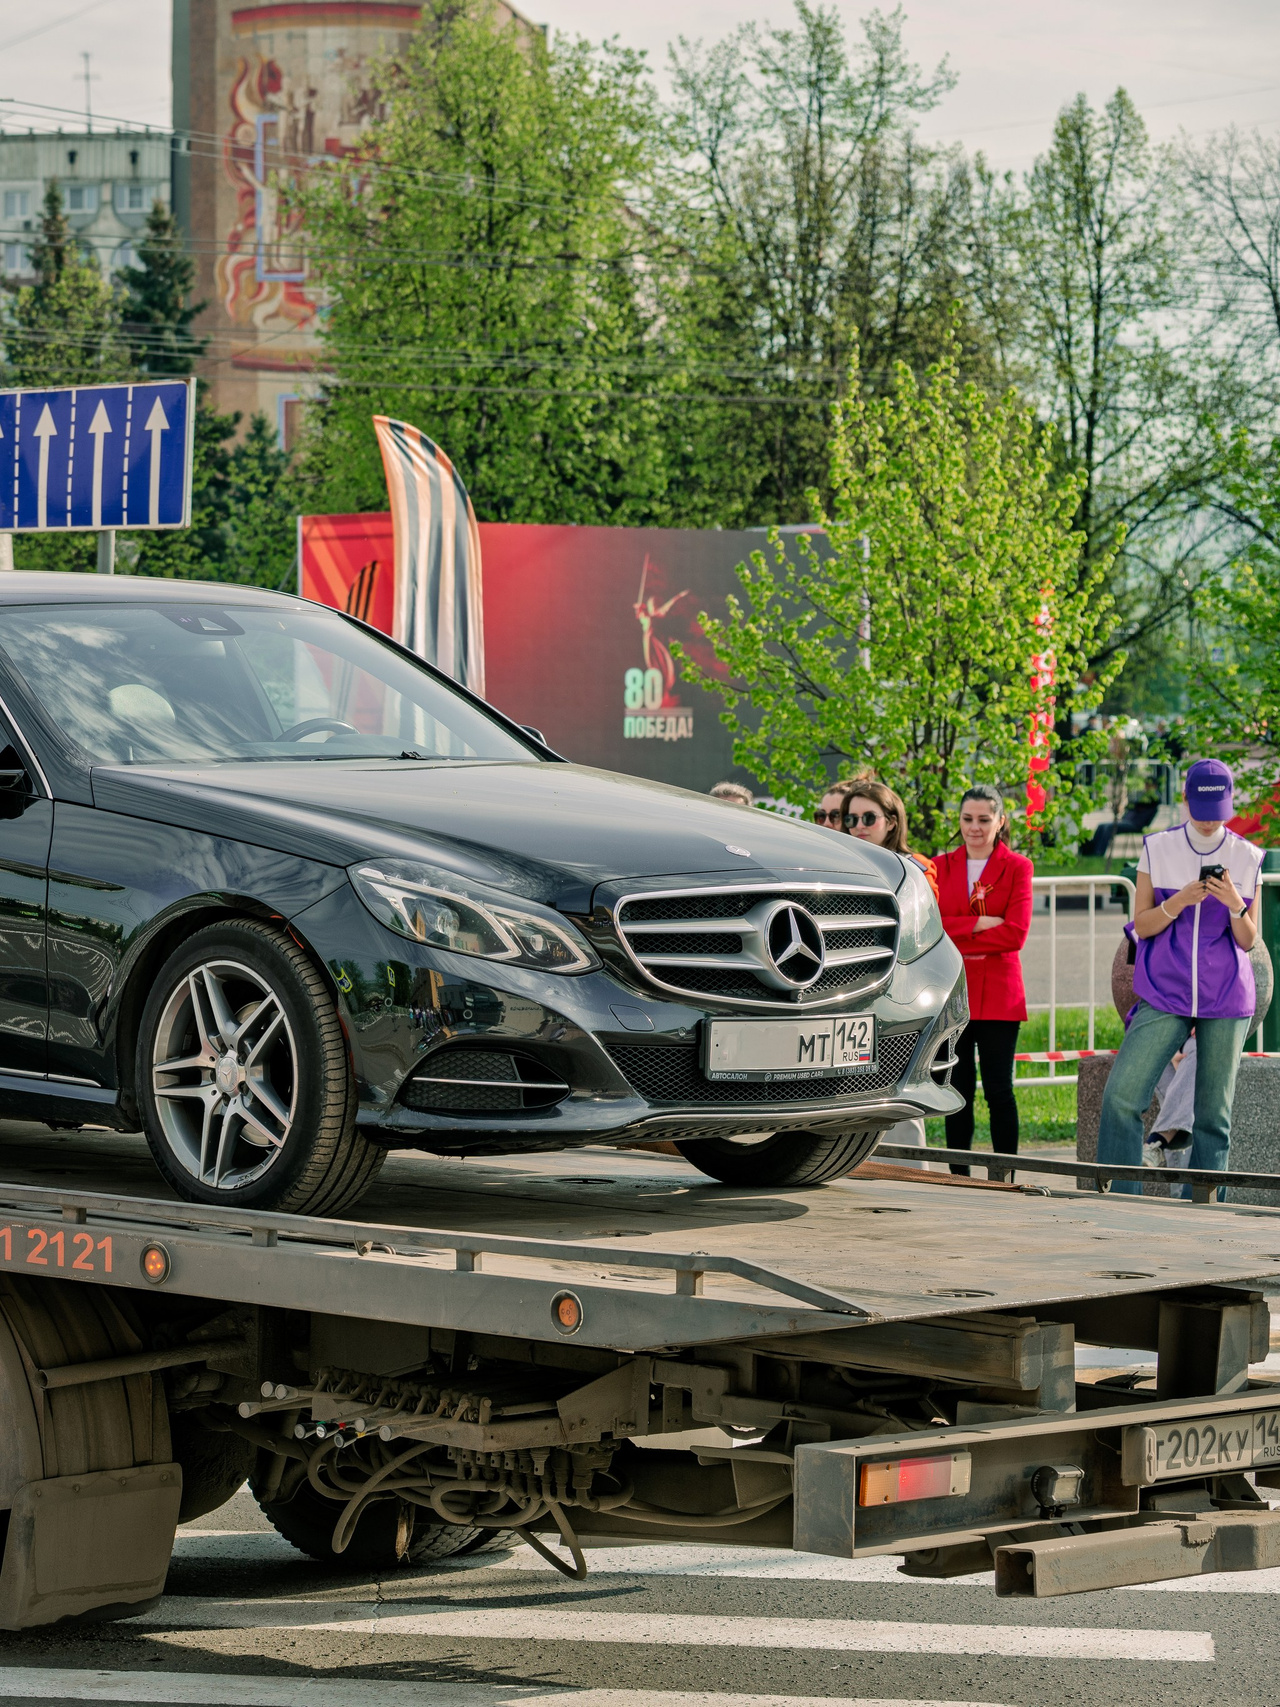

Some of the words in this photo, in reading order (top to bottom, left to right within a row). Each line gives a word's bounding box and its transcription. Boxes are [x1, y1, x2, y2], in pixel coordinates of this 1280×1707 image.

[624, 667, 663, 710] 80
[624, 716, 693, 741] ПОБЕДА!
[836, 1021, 868, 1050] 142
[842, 1051, 859, 1062] RUS
[711, 1072, 748, 1080] АВТОСАЛОН
[810, 1070, 824, 1078] CARS
[27, 1228, 113, 1272] 2121
